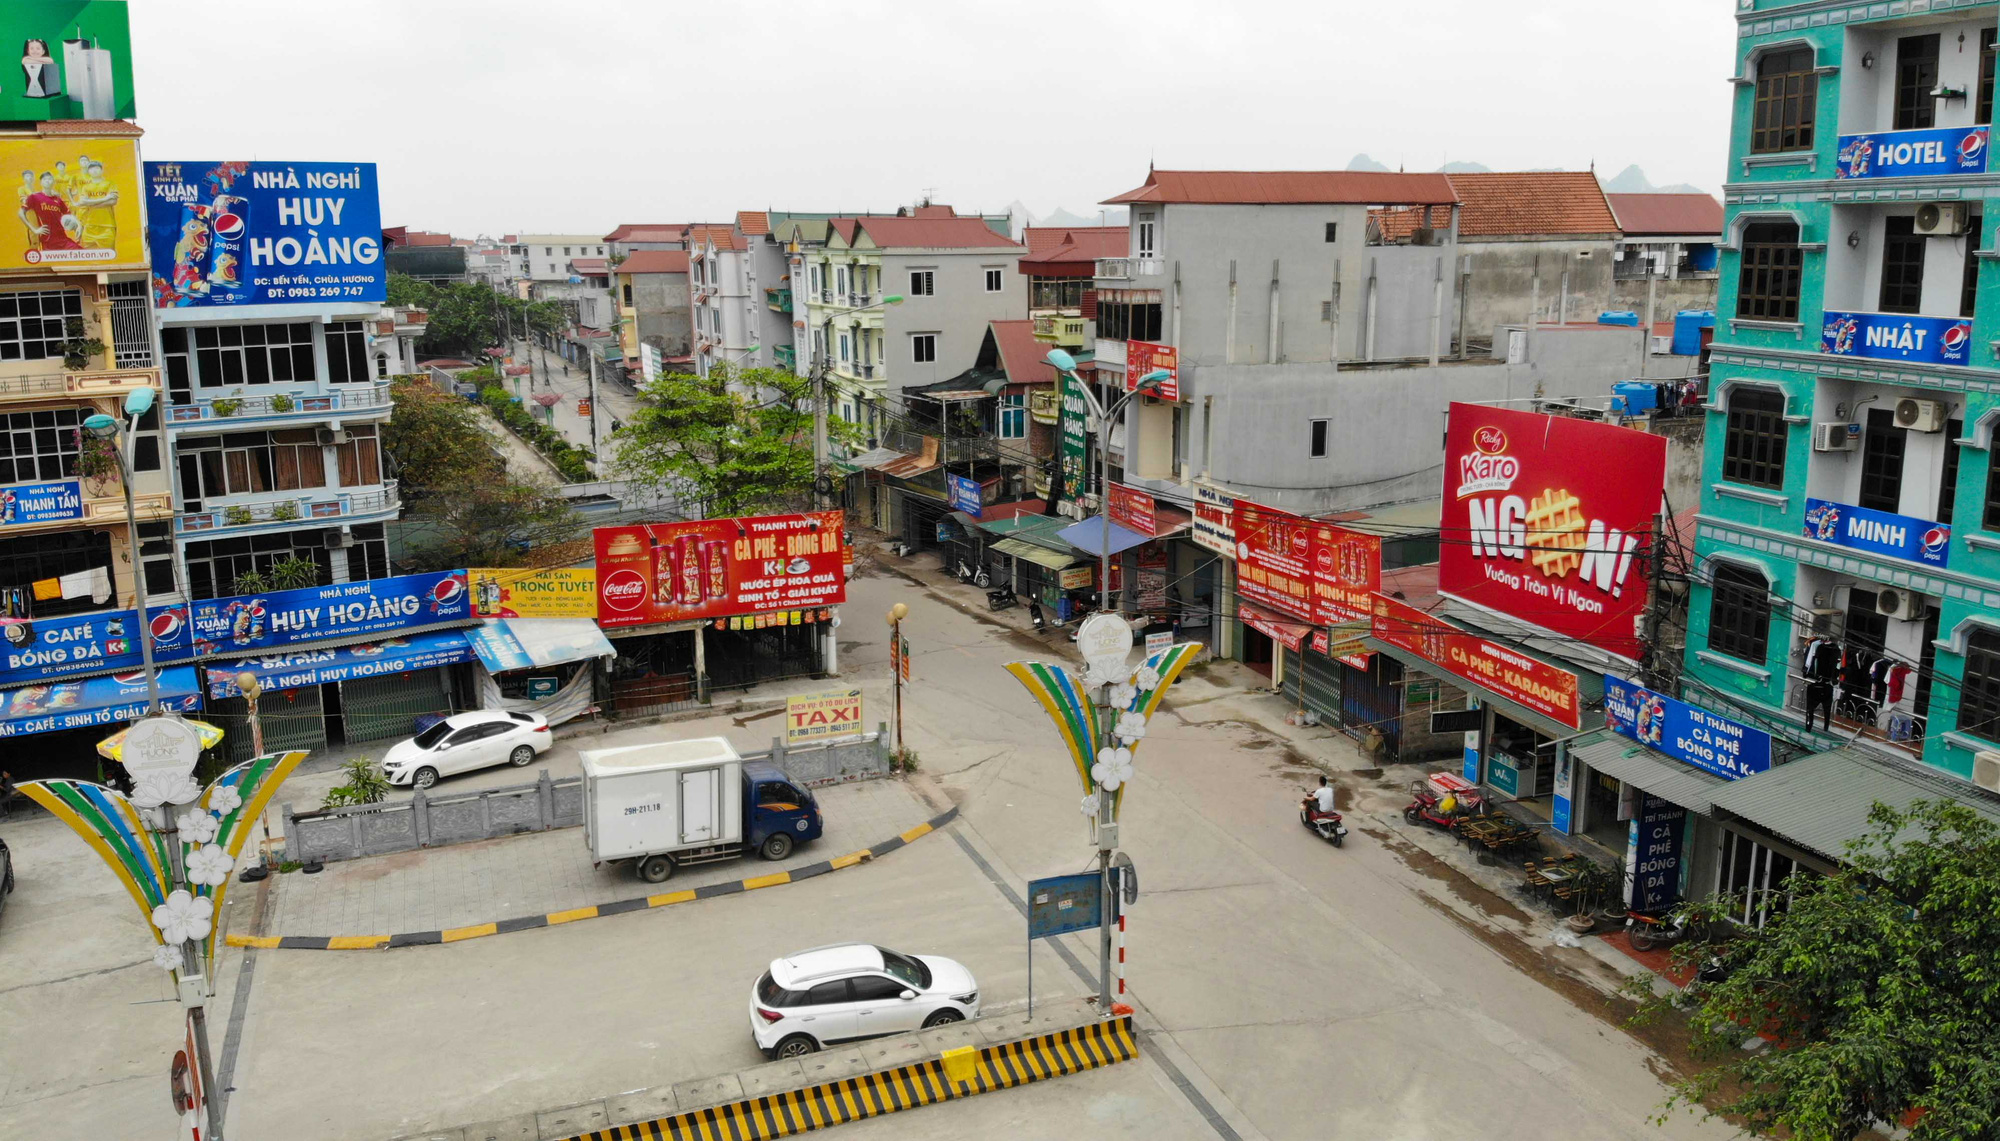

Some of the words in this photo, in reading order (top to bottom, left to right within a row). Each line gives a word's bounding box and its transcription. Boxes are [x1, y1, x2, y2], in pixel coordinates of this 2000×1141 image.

[1877, 141, 1947, 166] HOTEL
[157, 162, 182, 177] TẾT
[1961, 159, 1979, 168] pepsi
[253, 167, 300, 189] NHÀ
[306, 167, 360, 190] NGHỈ
[154, 183, 198, 198] XUÂN
[278, 197, 345, 226] HUY
[214, 242, 240, 252] pepsi
[250, 228, 379, 266] HOÀNG
[45, 250, 110, 261] www.falcon.vn
[254, 278, 271, 286] ĐC:
[273, 275, 290, 285] BẾN
[314, 275, 340, 285] CHÙA
[342, 276, 375, 284] HƯƠNG
[268, 288, 285, 298] ĐT:
[288, 287, 317, 298] 0983
[320, 287, 341, 297] 269
[344, 286, 364, 296] 747
[1866, 322, 1928, 356] NHẬT
[1944, 352, 1962, 360] pepsi
[1461, 452, 1518, 484] Karo
[29, 487, 45, 495] NHÀ
[46, 484, 66, 494] NGHỈ
[1199, 488, 1216, 501] NHÀ
[19, 497, 56, 513] THANH
[37, 510, 74, 520] 0983849638
[752, 522, 787, 532] THANH
[1848, 517, 1906, 548] MINH
[734, 536, 752, 561] CÀ
[754, 533, 777, 560] PHÊ
[787, 532, 819, 557] BÓNG
[821, 532, 838, 553] ĐÁ
[1924, 552, 1941, 561] pepsi
[763, 560, 783, 576] K+
[513, 581, 555, 595] TRỌNG
[558, 577, 595, 592] TUYẾT
[605, 581, 644, 597] Coca-Cola
[740, 580, 771, 591] NƯỚC
[773, 577, 787, 587] ÉP
[788, 577, 811, 586] HOA
[812, 572, 836, 584] QUẢ
[1484, 563, 1519, 590] Vuông
[1523, 574, 1548, 598] Tròn
[1551, 584, 1566, 606] Vị
[1567, 591, 1603, 614] Ngon
[320, 587, 342, 600] NHÀ
[344, 582, 371, 596] NGHỈ
[737, 593, 764, 603] SINH
[765, 589, 780, 601] TỐ
[788, 588, 810, 598] GIẢI
[810, 584, 839, 596] KHÁT
[1314, 582, 1345, 602] MINH
[437, 604, 462, 617] pepsi
[768, 600, 778, 609] Số
[783, 599, 801, 607] Chùa
[801, 596, 824, 606] Hương
[271, 607, 321, 633] HUY
[329, 595, 420, 626] HOÀNG
[196, 616, 230, 630] XUÂN
[44, 622, 94, 644] CAFÉ
[9, 645, 68, 669] BÓNG
[73, 642, 102, 660] ĐÁ
[107, 642, 127, 654] K+
[154, 642, 183, 654] pepsi
[449, 656, 460, 664] 747
[1480, 643, 1500, 658] MINH
[1500, 650, 1532, 672] NGUYỆT
[279, 669, 317, 687] NGHỈ
[320, 668, 349, 682] HUY
[352, 660, 406, 677] HOÀNG
[1450, 646, 1469, 667] CÀ
[1470, 656, 1495, 678] PHÊ
[1503, 669, 1570, 711] KARAOKE
[120, 684, 162, 696] pepi
[790, 703, 807, 712] DỊCH
[819, 700, 824, 708] Ô
[825, 699, 833, 708] TÔ
[844, 697, 859, 706] LỊCH
[1607, 698, 1635, 719] XUÂN
[25, 716, 56, 733] CAFÉ
[64, 713, 93, 728] SINH
[95, 707, 111, 723] TỐ
[113, 705, 141, 720] GIẢI
[790, 706, 860, 727] TAXI
[1689, 709, 1705, 725] TRÍ
[1706, 716, 1743, 739] THÀNH
[842, 722, 851, 731] 511
[851, 721, 860, 730] 377
[1692, 728, 1712, 745] CÀ
[1715, 736, 1741, 757] PHÊ
[1677, 736, 1715, 762] BÓNG
[1716, 751, 1738, 772] ĐÁ
[1740, 762, 1756, 776] K+
[623, 802, 661, 816] 29H-211.18
[1645, 813, 1657, 824] TRÍ
[1657, 809, 1684, 821] THÀNH
[1652, 823, 1671, 839] CÀ
[1648, 839, 1672, 856] PHÊ
[1640, 857, 1676, 874] BÓNG
[1648, 872, 1665, 888] ĐÁ
[1647, 892, 1662, 904] K+
